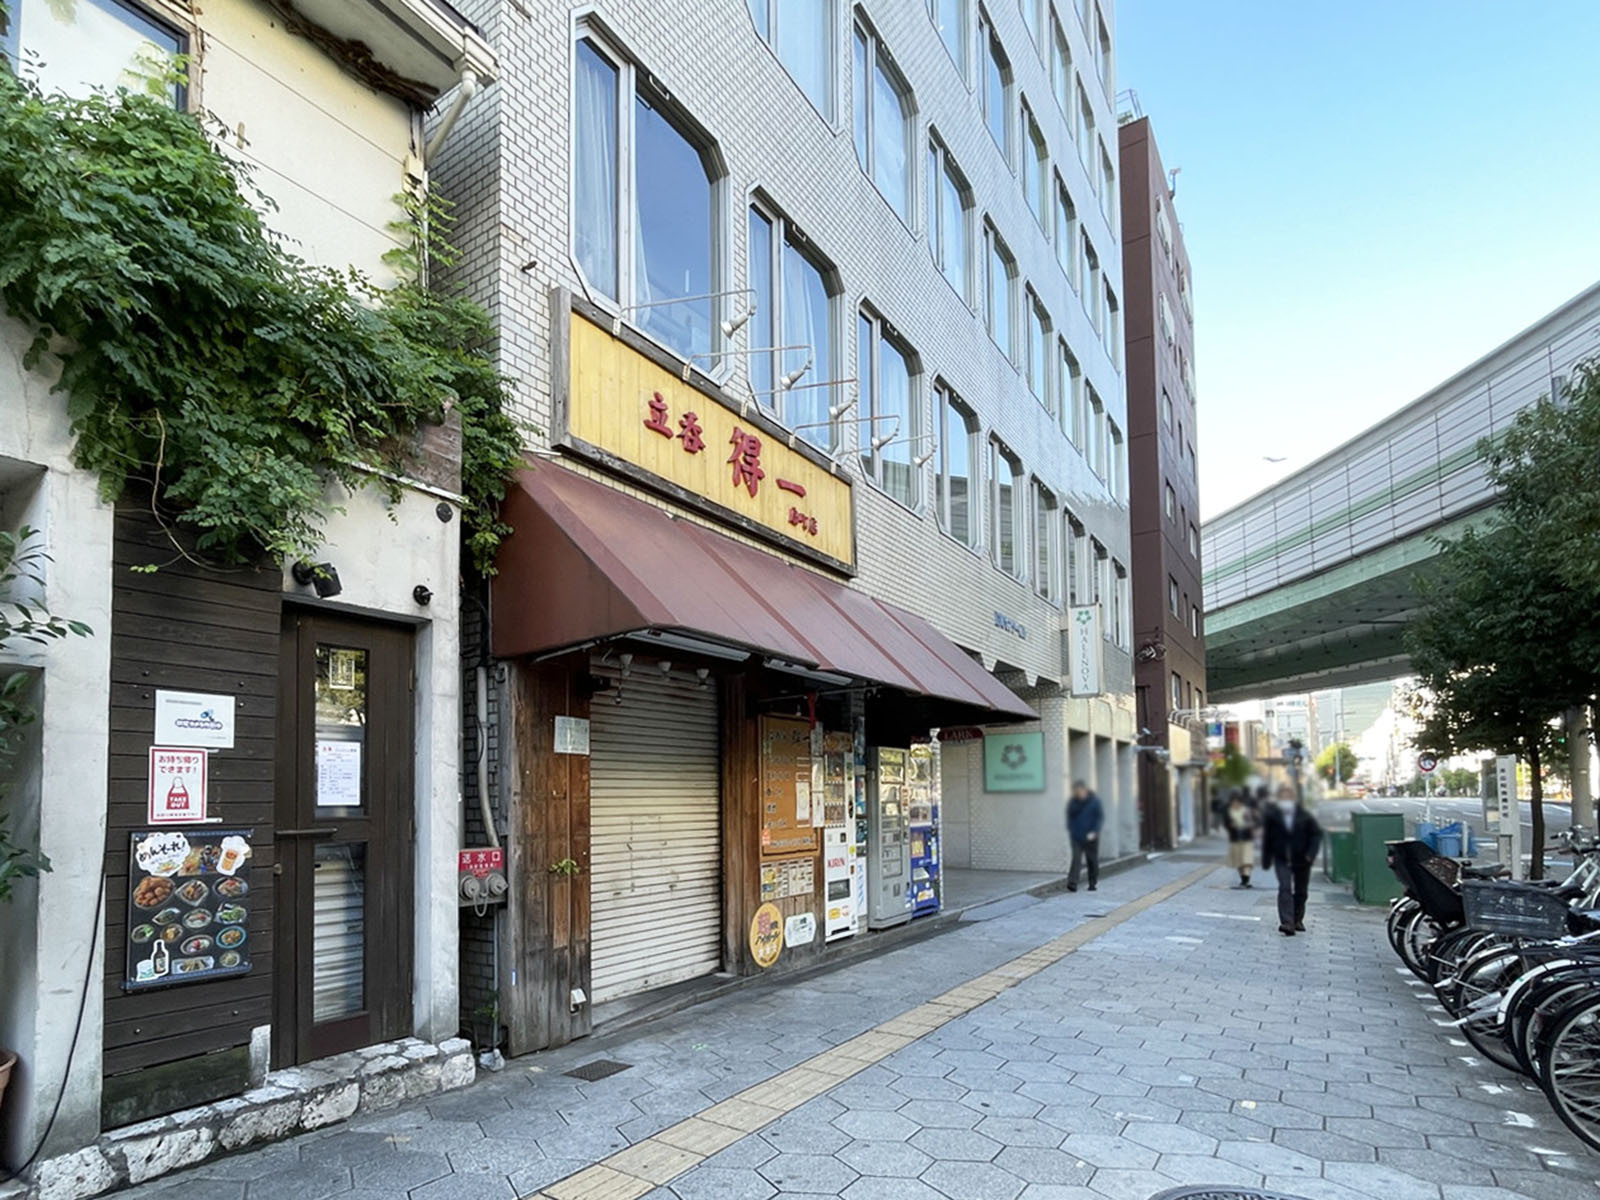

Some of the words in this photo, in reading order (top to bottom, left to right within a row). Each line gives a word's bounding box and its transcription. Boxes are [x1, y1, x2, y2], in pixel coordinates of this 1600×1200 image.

[643, 391, 706, 455] 立呑
[727, 426, 807, 498] 得一
[159, 755, 200, 764] お持ち帰り
[462, 851, 501, 864] 送水口
[828, 857, 845, 868] KIRIN
